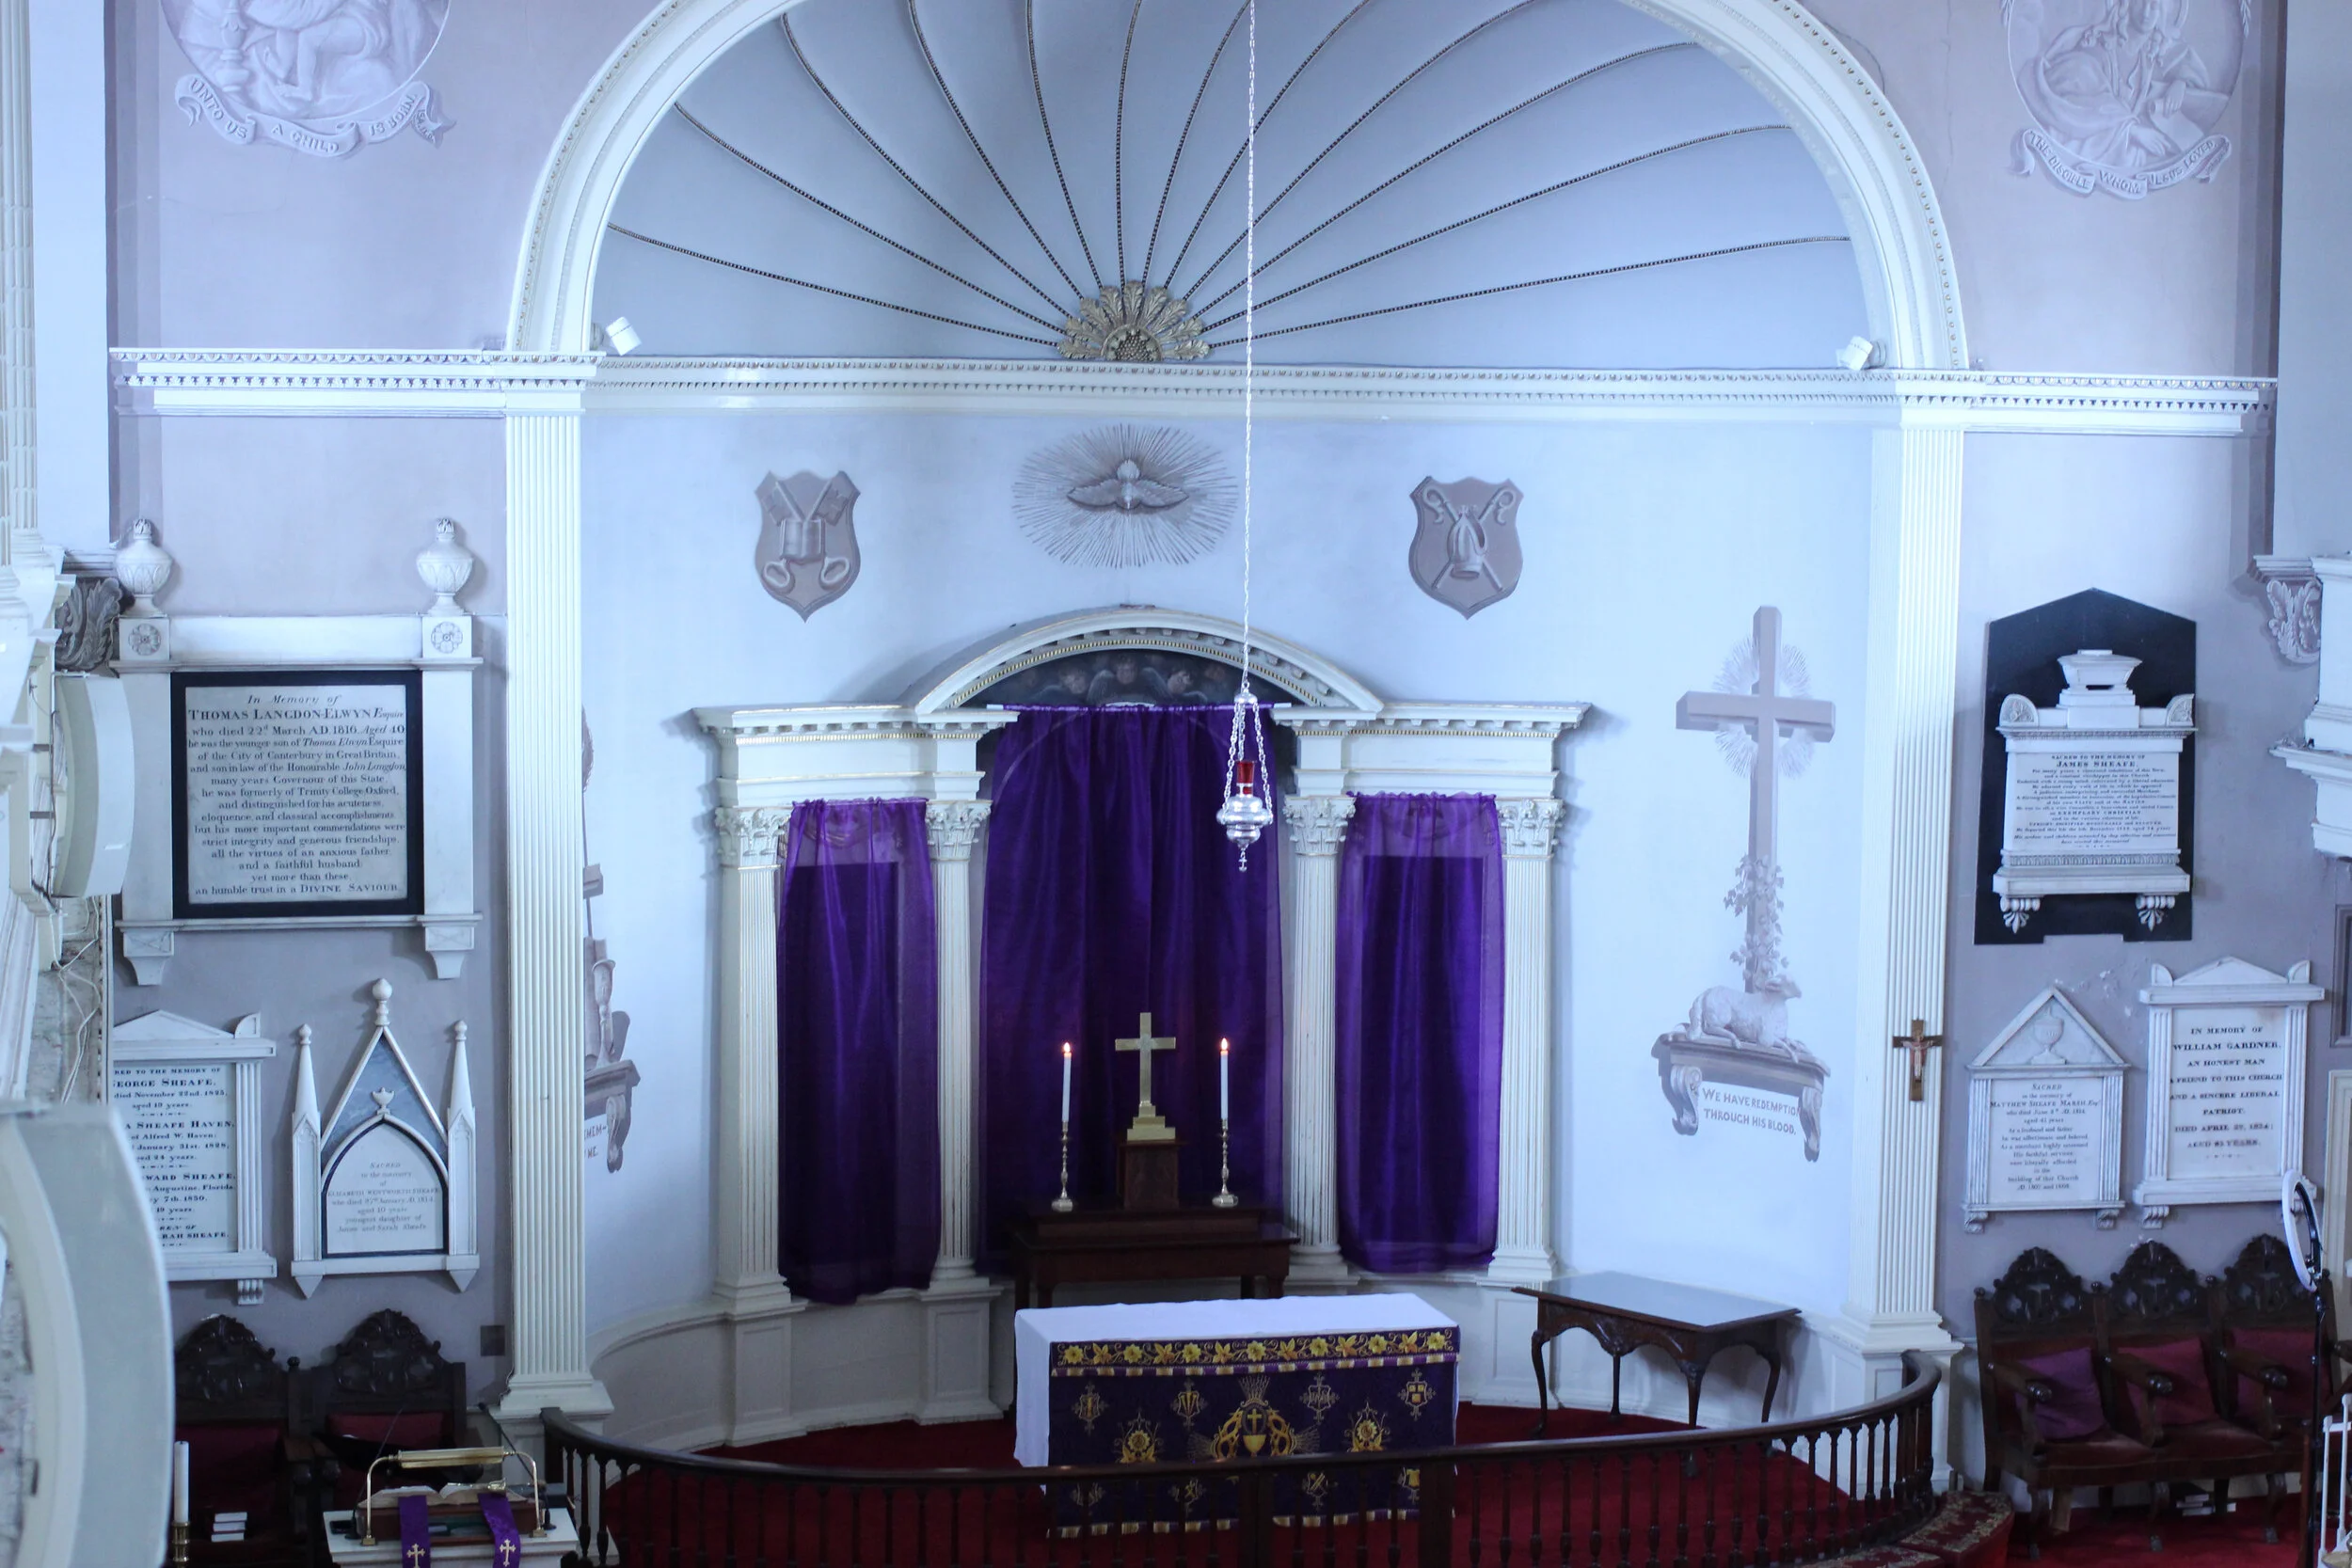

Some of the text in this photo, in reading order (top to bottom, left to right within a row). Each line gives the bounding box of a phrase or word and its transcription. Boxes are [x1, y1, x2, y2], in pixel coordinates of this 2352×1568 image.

[191, 78, 224, 120] UNTO
[227, 120, 248, 139] US
[272, 123, 283, 135] A
[292, 132, 340, 152] CHILD
[388, 94, 417, 129] BORN
[247, 695, 320, 705] In Memory
[188, 710, 248, 721] THOMAS
[373, 707, 404, 721] Esquire
[219, 726, 244, 736] died
[272, 726, 306, 736] March
[363, 724, 388, 737] Aged
[234, 736, 404, 750] younger Thomas Elwyn Esquire
[231, 752, 251, 761] City
[268, 751, 322, 762] Canterbury
[337, 750, 362, 759] Great
[240, 764, 254, 772] law
[288, 762, 340, 772] Honourable
[343, 762, 366, 772] John
[211, 774, 357, 786] many years Governour this
[240, 788, 281, 799] formerly
[297, 787, 330, 798] Trinity
[241, 800, 305, 811] distinguished
[278, 811, 318, 820] classical
[195, 825, 210, 833] but
[262, 825, 310, 836] important
[313, 822, 381, 832] commendations
[202, 837, 227, 846] strict
[231, 837, 274, 848] integrity
[300, 837, 342, 847] generous
[211, 849, 225, 858] all
[319, 848, 358, 857] anxious
[275, 860, 313, 869] faithful
[251, 875, 267, 883] yet
[300, 872, 321, 880] than
[211, 886, 247, 895] humble
[250, 886, 274, 895] trust
[300, 884, 342, 894] DIVINE
[2206, 1026, 2247, 1035] MEMORY
[2172, 1043, 2222, 1052] WILLIAM
[1702, 1087, 1721, 1101] WE
[1724, 1092, 1750, 1107] HAVE
[1703, 1108, 1750, 1125] THROUGH
[1752, 1117, 1766, 1130] HIS
[2201, 1124, 2230, 1132] APRIL
